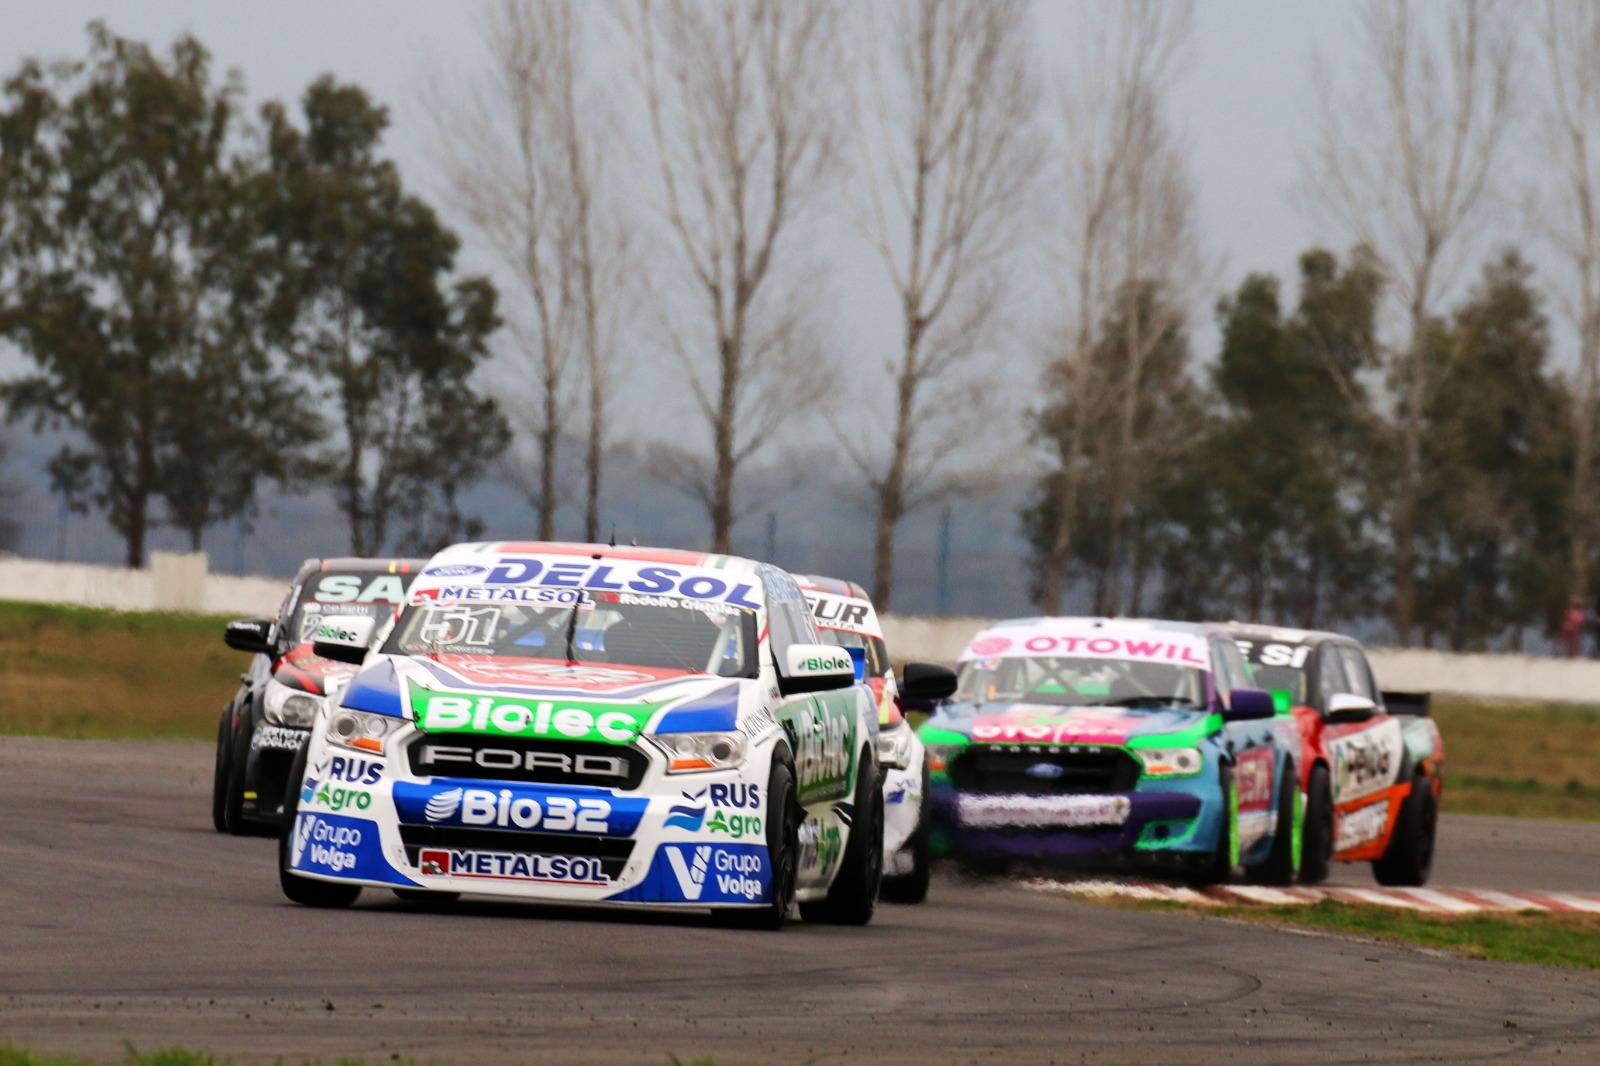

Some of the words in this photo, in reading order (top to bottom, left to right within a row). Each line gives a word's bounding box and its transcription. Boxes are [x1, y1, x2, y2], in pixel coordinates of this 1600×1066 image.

[442, 588, 593, 605] METALSOL
[484, 558, 762, 610] DELSOL
[318, 625, 358, 642] Biolec
[420, 606, 500, 645] 51
[807, 656, 851, 671] Biolec
[1025, 636, 1206, 664] OTOWIL
[424, 696, 639, 741] Biolec
[330, 756, 384, 785] RUS
[420, 745, 628, 778] FORD
[316, 782, 373, 811] Agro
[710, 783, 760, 809] RUS
[461, 789, 612, 833] Bio32
[706, 810, 762, 838] Agro
[313, 820, 362, 848] Grupo
[310, 843, 357, 871] Volga
[451, 852, 608, 881] METALSOL
[715, 849, 761, 875] Grupo
[715, 874, 762, 899] Volga
